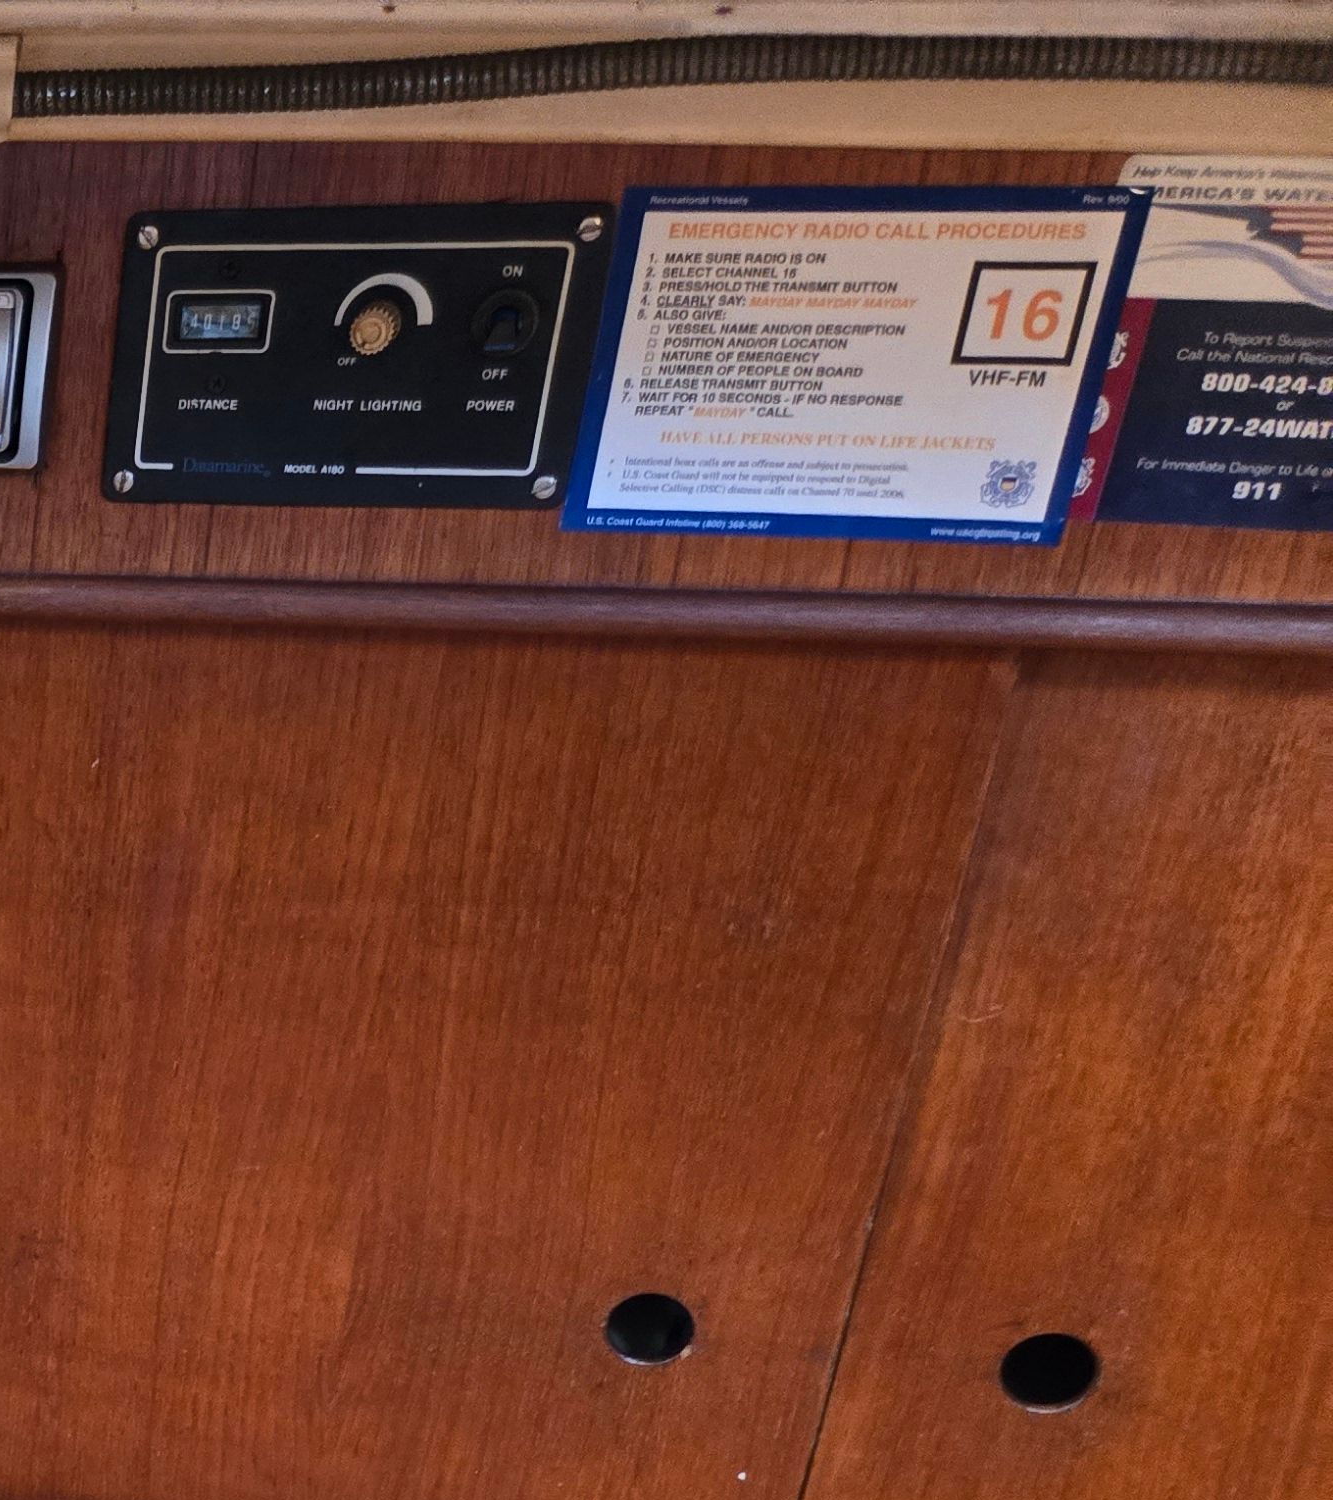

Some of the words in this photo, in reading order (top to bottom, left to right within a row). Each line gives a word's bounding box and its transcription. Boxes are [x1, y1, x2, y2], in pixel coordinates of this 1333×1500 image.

[668, 222, 799, 240] EMERGENCY
[803, 222, 869, 240] RADIO
[875, 223, 930, 240] CALL
[937, 223, 1087, 240] PROCEDURES
[649, 254, 657, 264] 1.
[664, 254, 702, 264] MAKE
[705, 254, 741, 264] SURE
[744, 254, 787, 264] RADIO
[789, 254, 802, 264] IS
[805, 253, 826, 264] ON
[502, 265, 524, 278] ON
[646, 267, 655, 278] 2.
[662, 268, 711, 278] SELECT
[715, 268, 778, 278] CHANNEL
[642, 282, 652, 292] 3.
[659, 282, 741, 292] PRESS/HOLD
[744, 282, 769, 292] THE
[772, 282, 840, 293] TRANSMIT
[842, 282, 898, 293] BUTTON
[640, 296, 651, 306] 4.
[657, 296, 713, 308] CLEARLY
[717, 296, 746, 308] SAY:
[749, 297, 805, 308] MAYDAY
[806, 298, 860, 308] MAYDAY
[862, 298, 917, 309] MAYDAY
[653, 310, 689, 320] ALSO
[692, 310, 727, 320] GIVE:
[986, 289, 1063, 341] 16
[667, 324, 716, 334] VESSEL
[720, 324, 759, 334] NAME
[761, 325, 812, 335] AND/OR
[815, 325, 905, 335] DESCRIPTION
[663, 338, 723, 348] POSITION
[727, 338, 777, 348] AND/OR
[783, 338, 848, 349] LOCATION
[1204, 331, 1219, 344] To
[1223, 333, 1273, 347] Report
[337, 356, 357, 367] OFF
[661, 352, 712, 362] NATURE
[715, 352, 733, 362] OF
[737, 352, 820, 362] EMERGENCY
[1177, 348, 1203, 361] Call
[1207, 350, 1231, 362] the
[1235, 351, 1294, 364] National
[481, 368, 509, 381] OFF
[658, 366, 716, 376] NUMBER
[720, 366, 735, 376] OF
[738, 366, 790, 376] PEOPLE
[793, 366, 813, 377] ON
[817, 367, 863, 377] BOARD
[969, 370, 1047, 387] VHF-FM
[639, 379, 699, 390] RELEASE
[701, 379, 768, 390] TRANSMIT
[770, 380, 823, 391] BUTTON
[177, 398, 238, 411] DISTANCE
[638, 392, 669, 403] WAIT
[672, 393, 698, 403] FOR
[702, 393, 716, 403] 10
[719, 393, 781, 404] SECONDS
[792, 395, 805, 405] IF
[807, 395, 827, 405] NO
[830, 395, 903, 406] RESPONSE
[312, 399, 354, 412] NIGHT
[359, 400, 422, 412] LIGHTING
[465, 400, 515, 412] POWER
[634, 406, 684, 416] REPEAT
[1277, 401, 1295, 411] or
[1186, 415, 1333, 439] 877-24WAT
[661, 431, 701, 443] HAVE
[708, 432, 734, 443] ALL
[740, 433, 812, 445] PERSONS
[817, 434, 851, 445] PUT
[852, 435, 877, 446] ON
[880, 436, 917, 448] LIFE
[920, 437, 997, 450] JACKETS
[284, 464, 317, 474] MODEL
[1137, 458, 1158, 469] For
[1161, 459, 1226, 473] Immediate
[1229, 461, 1276, 476] Danger
[1279, 464, 1293, 475] to
[1296, 464, 1319, 476] Life
[1232, 481, 1282, 500] 911
[607, 517, 634, 527] Coast
[635, 518, 664, 527] Guard
